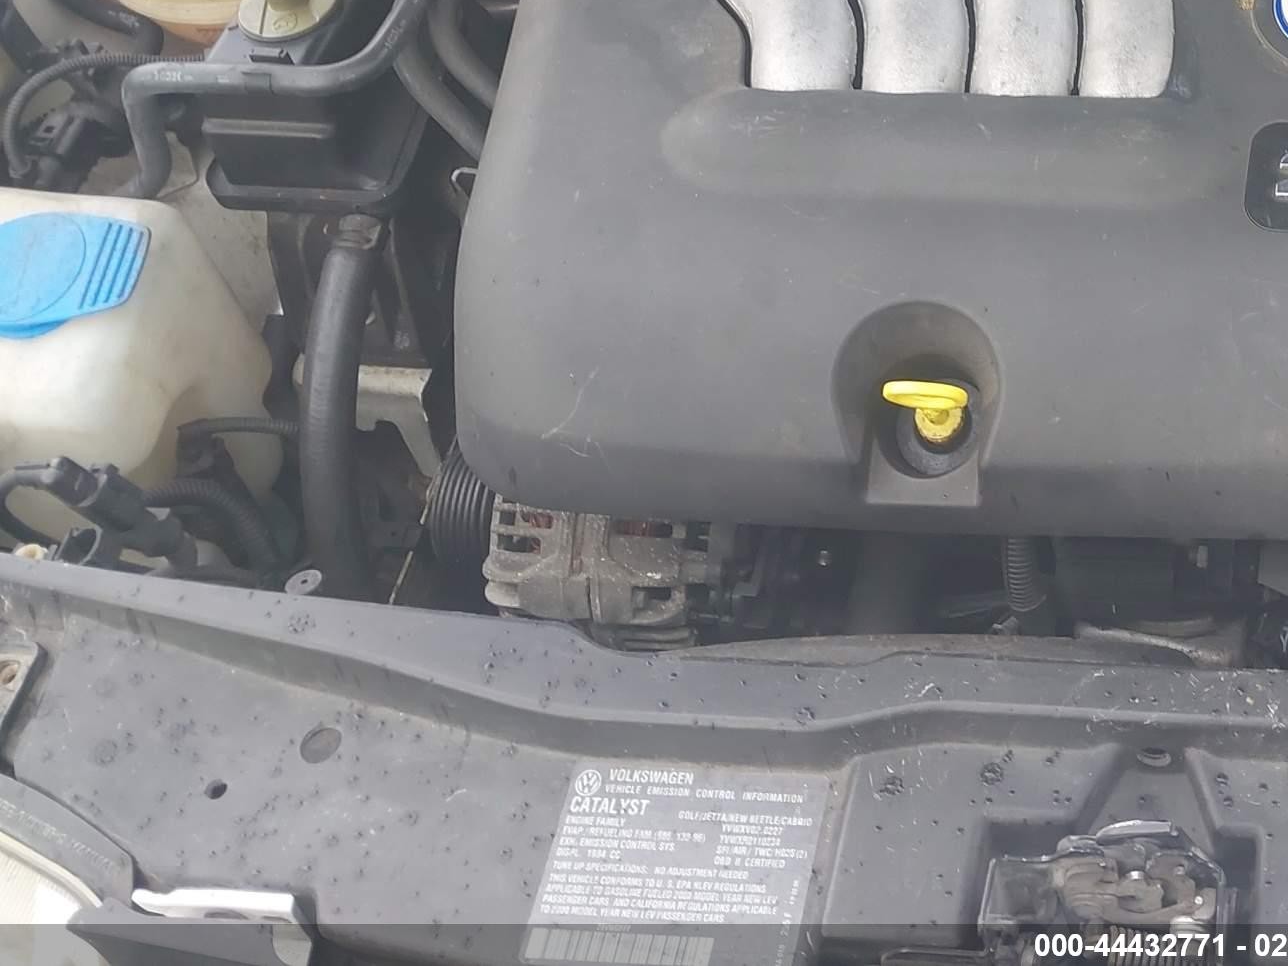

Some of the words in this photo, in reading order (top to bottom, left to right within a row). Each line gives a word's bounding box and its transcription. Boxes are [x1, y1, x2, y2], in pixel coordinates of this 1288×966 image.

[609, 768, 694, 785] VOLKSWAGEN
[605, 783, 641, 793] VEHICLE
[648, 786, 689, 796] EMISSION
[696, 788, 736, 799] CONTROL
[743, 791, 804, 803] INFORMATION
[570, 796, 650, 815] CATALYST
[596, 817, 626, 826] FAMILY
[580, 839, 618, 847] EMISSION
[620, 841, 656, 849] CONTROL
[714, 856, 731, 864] OBD
[745, 858, 786, 867] CERTIFIED
[655, 866, 665, 874] NO
[667, 867, 717, 877] ADJUSTMENT
[719, 870, 749, 879] NEEDED
[568, 875, 598, 883] VEHICLE
[600, 876, 643, 885] CONFORMS
[715, 882, 767, 892] REGULATIONS
[542, 894, 588, 903] PASSENGER
[614, 898, 629, 906] AND
[631, 899, 676, 909] CALIFORNIA
[677, 902, 730, 912] REGULATIONS
[732, 904, 777, 914] APPLICABLE
[723, 893, 742, 901] YEAR
[744, 894, 761, 902] NEW
[540, 905, 550, 913] TO
[621, 909, 639, 917] NEW
[656, 911, 702, 921] PASSENGER
